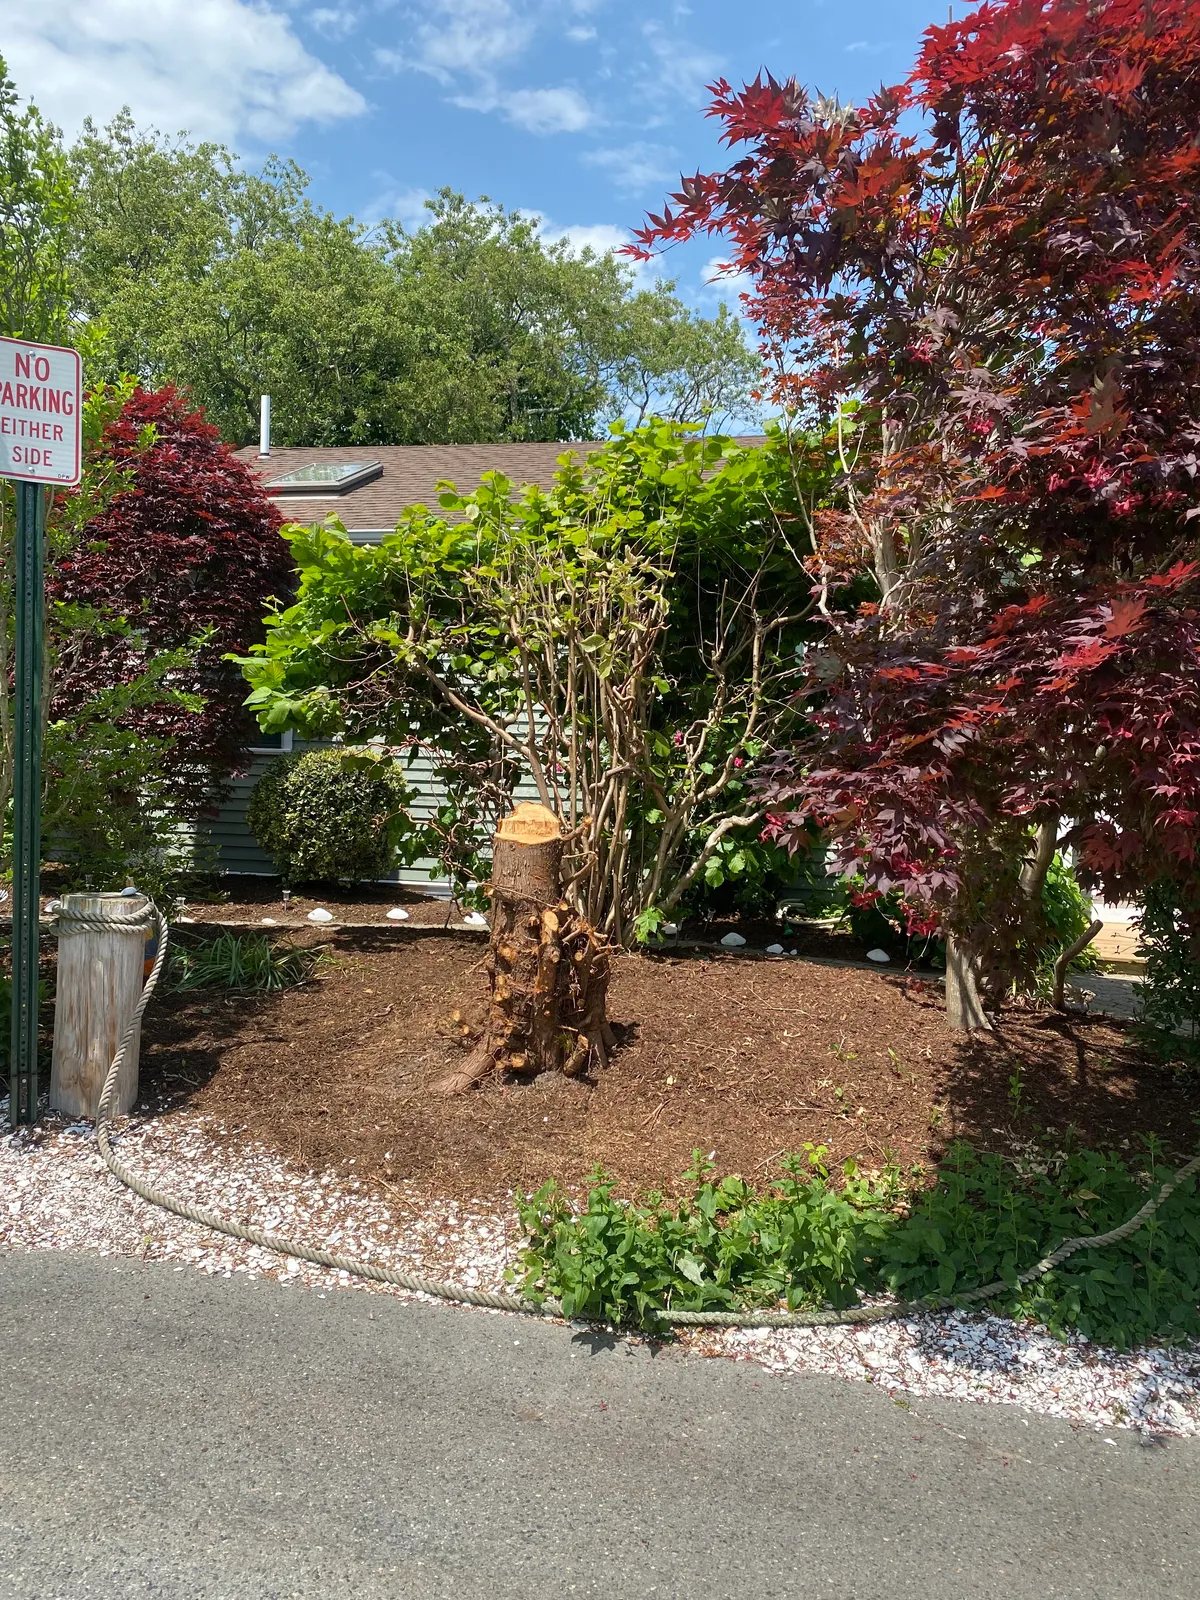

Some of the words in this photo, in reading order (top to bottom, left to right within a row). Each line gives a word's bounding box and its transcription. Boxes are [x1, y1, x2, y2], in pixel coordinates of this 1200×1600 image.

[15, 352, 50, 382] NO
[0, 381, 73, 416] ARKING
[1, 416, 63, 442] EITHER
[12, 445, 53, 467] SIDE
